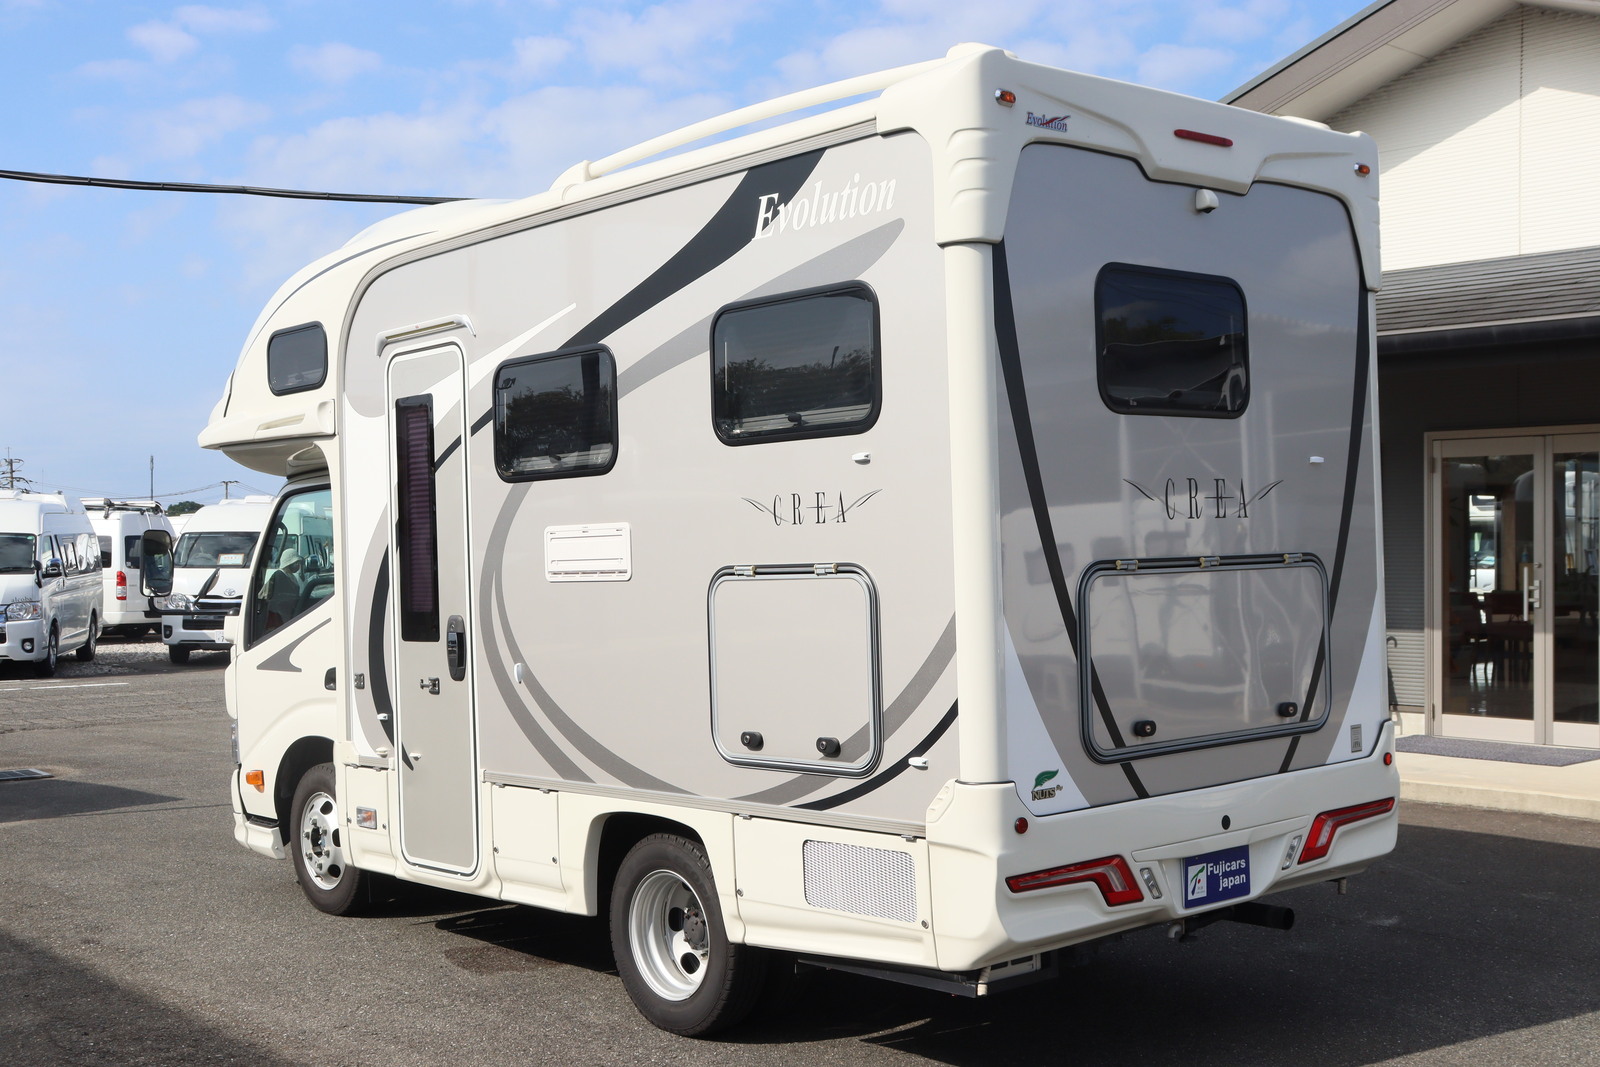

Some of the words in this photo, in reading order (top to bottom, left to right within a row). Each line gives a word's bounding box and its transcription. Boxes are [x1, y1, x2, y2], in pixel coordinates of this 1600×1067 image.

[1025, 111, 1067, 132] Evolution
[752, 172, 897, 241] Evolution
[773, 490, 847, 526] CREA
[1164, 477, 1249, 520] CREA
[1031, 787, 1056, 801] NUTS
[1207, 859, 1246, 876] Fujicars
[1219, 874, 1246, 891] japan
